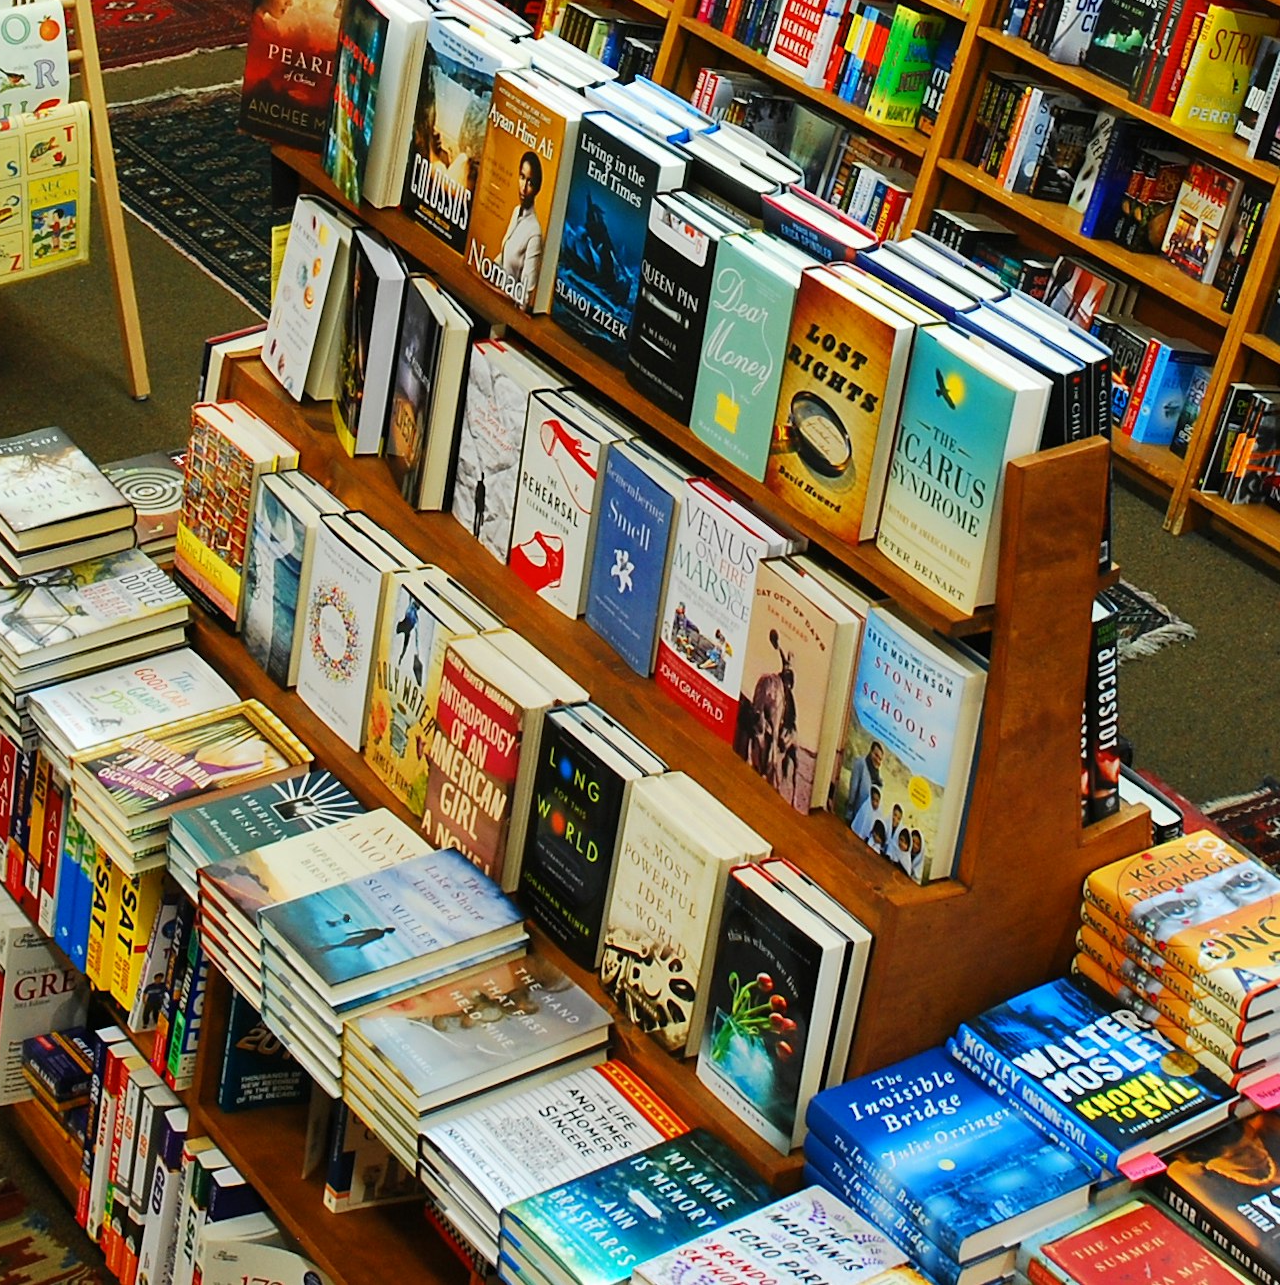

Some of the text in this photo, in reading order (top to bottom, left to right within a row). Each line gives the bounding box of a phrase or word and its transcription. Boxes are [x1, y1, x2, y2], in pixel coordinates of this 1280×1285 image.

[488, 102, 516, 138] Ayaan
[515, 119, 540, 152] Hirsi
[535, 133, 554, 162] Ali
[579, 132, 646, 188] Living in the
[409, 152, 473, 232] COLOSSUS
[586, 162, 643, 210] End Times
[466, 239, 529, 306] Nomad
[712, 267, 770, 325] Dear
[702, 317, 773, 396] Money
[805, 323, 869, 373] LOST
[788, 343, 879, 414] RIGHTS
[895, 423, 988, 511] ICARUS
[521, 471, 580, 530] REHEARSAL
[607, 499, 651, 552] Smell
[890, 462, 980, 539] SYNDROME
[683, 496, 759, 571] VENUS
[120, 574, 164, 607] DOYLE
[695, 542, 748, 590] ON FIRE
[879, 530, 912, 565] PETER
[911, 553, 966, 602] BEINART
[873, 655, 934, 710] STONES
[439, 675, 516, 757] ANTHROPOLOGY
[450, 719, 488, 768] OF AN
[862, 683, 938, 750] SCHOOLS
[430, 731, 508, 822] AMERICAN
[439, 782, 478, 840] GIRL
[623, 845, 697, 920] POWERFUL
[1128, 850, 1202, 882] KEITH
[364, 878, 438, 948] SUE MILLER
[13, 969, 77, 1001] GRE
[483, 978, 548, 1036] THAT FIRST
[515, 967, 579, 1025] THE HAND
[1231, 966, 1271, 994] A
[449, 991, 515, 1049] HELD MINE
[1013, 1008, 1150, 1081] WALTER
[872, 1073, 903, 1090] The
[1042, 1026, 1178, 1103] MOSLEY
[568, 1089, 596, 1116] AND
[594, 1111, 632, 1149] TIMES
[848, 1070, 956, 1122] Invisible
[880, 1094, 962, 1134] Bridge
[1076, 1070, 1164, 1122] KNOWN
[1109, 1079, 1202, 1126] TO EVIL
[630, 1156, 718, 1228] IS MEMORY
[664, 1149, 735, 1211] MY NAME
[1071, 1219, 1152, 1261] THE LOST
